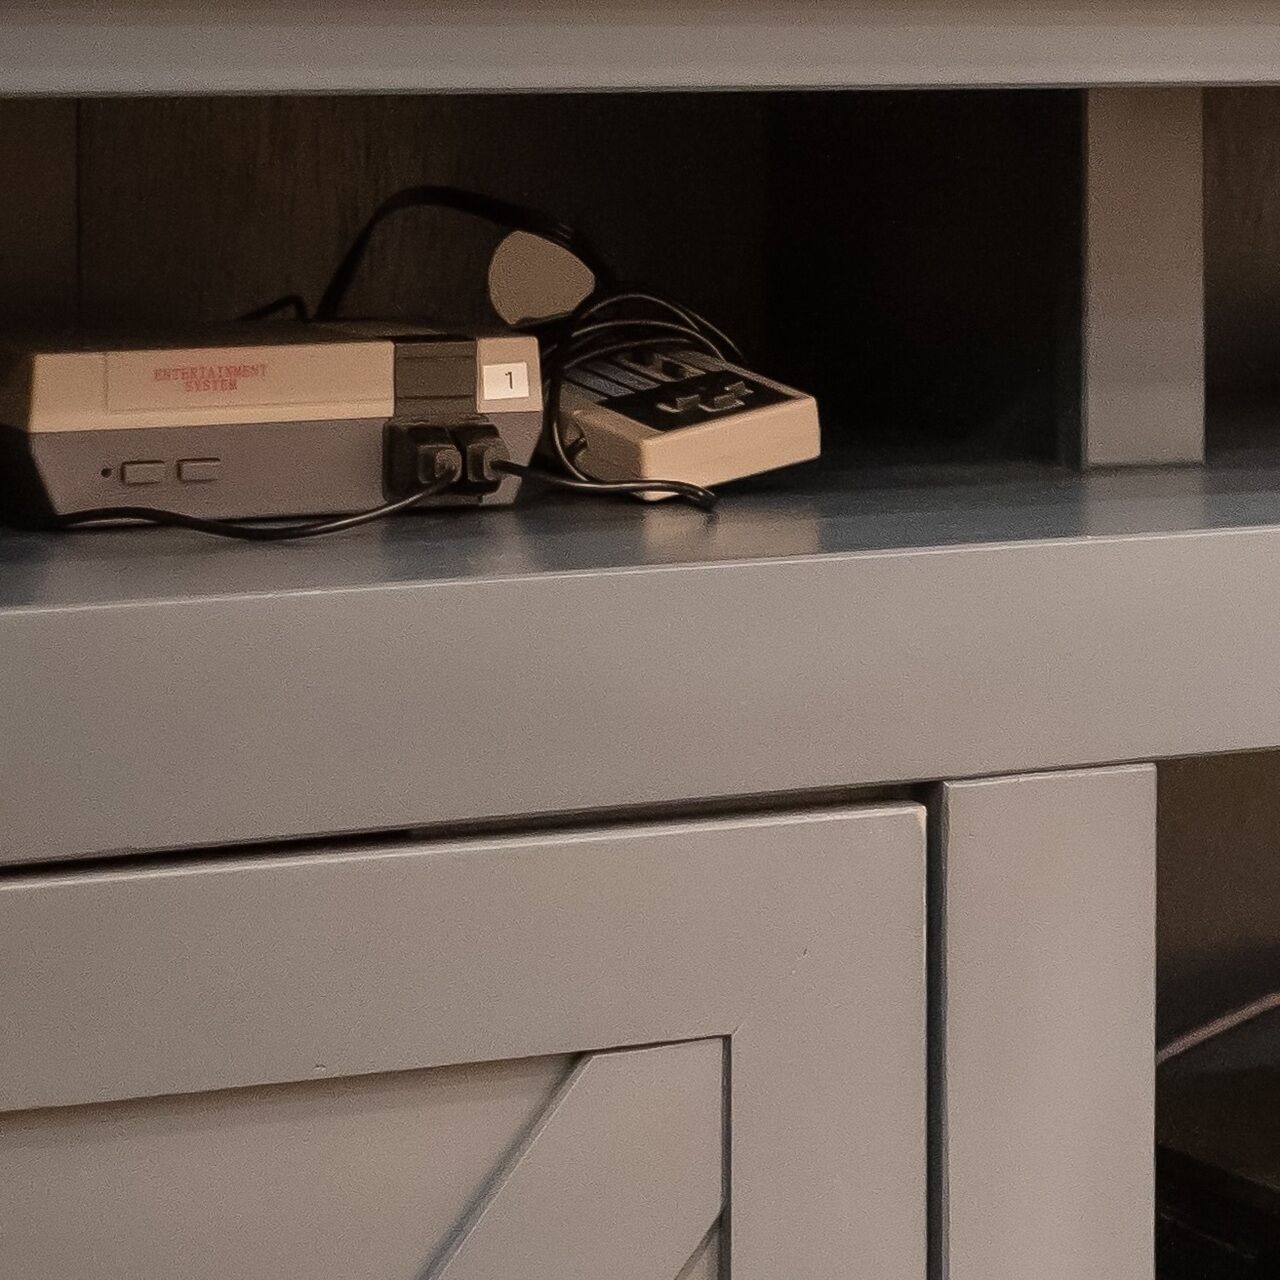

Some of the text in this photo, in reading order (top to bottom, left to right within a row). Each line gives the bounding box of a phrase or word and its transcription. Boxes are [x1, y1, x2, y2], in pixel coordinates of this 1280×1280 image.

[152, 363, 268, 382] ENTERTAINMENT
[504, 371, 514, 389] 1
[184, 378, 239, 392] SYSTEM
